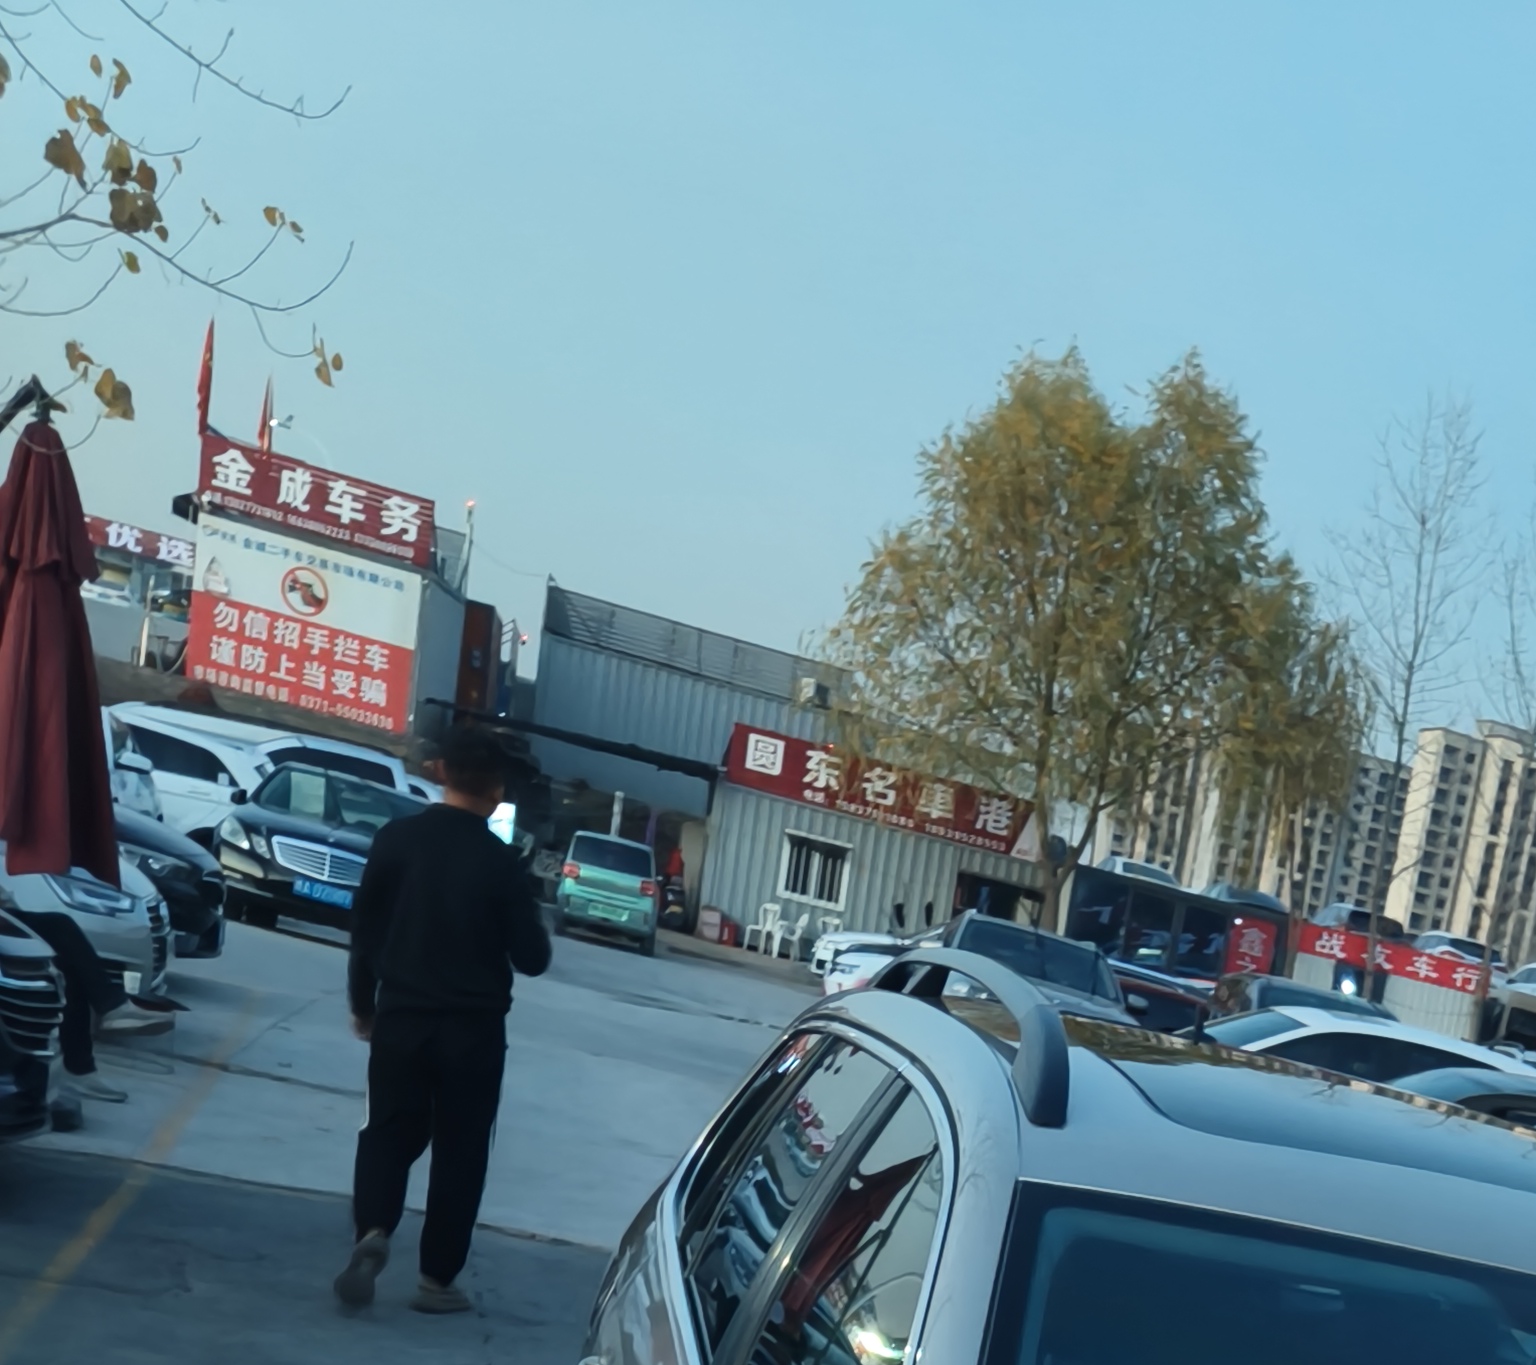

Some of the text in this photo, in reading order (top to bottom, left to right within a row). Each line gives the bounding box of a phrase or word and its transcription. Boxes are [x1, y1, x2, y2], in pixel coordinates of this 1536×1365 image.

[211, 448, 422, 542] 金成车务
[84, 517, 194, 568] 优选
[210, 635, 387, 707] 谨防上当受骗
[213, 602, 390, 672] 勿信招手拦车
[1315, 931, 1482, 991] 战友车行
